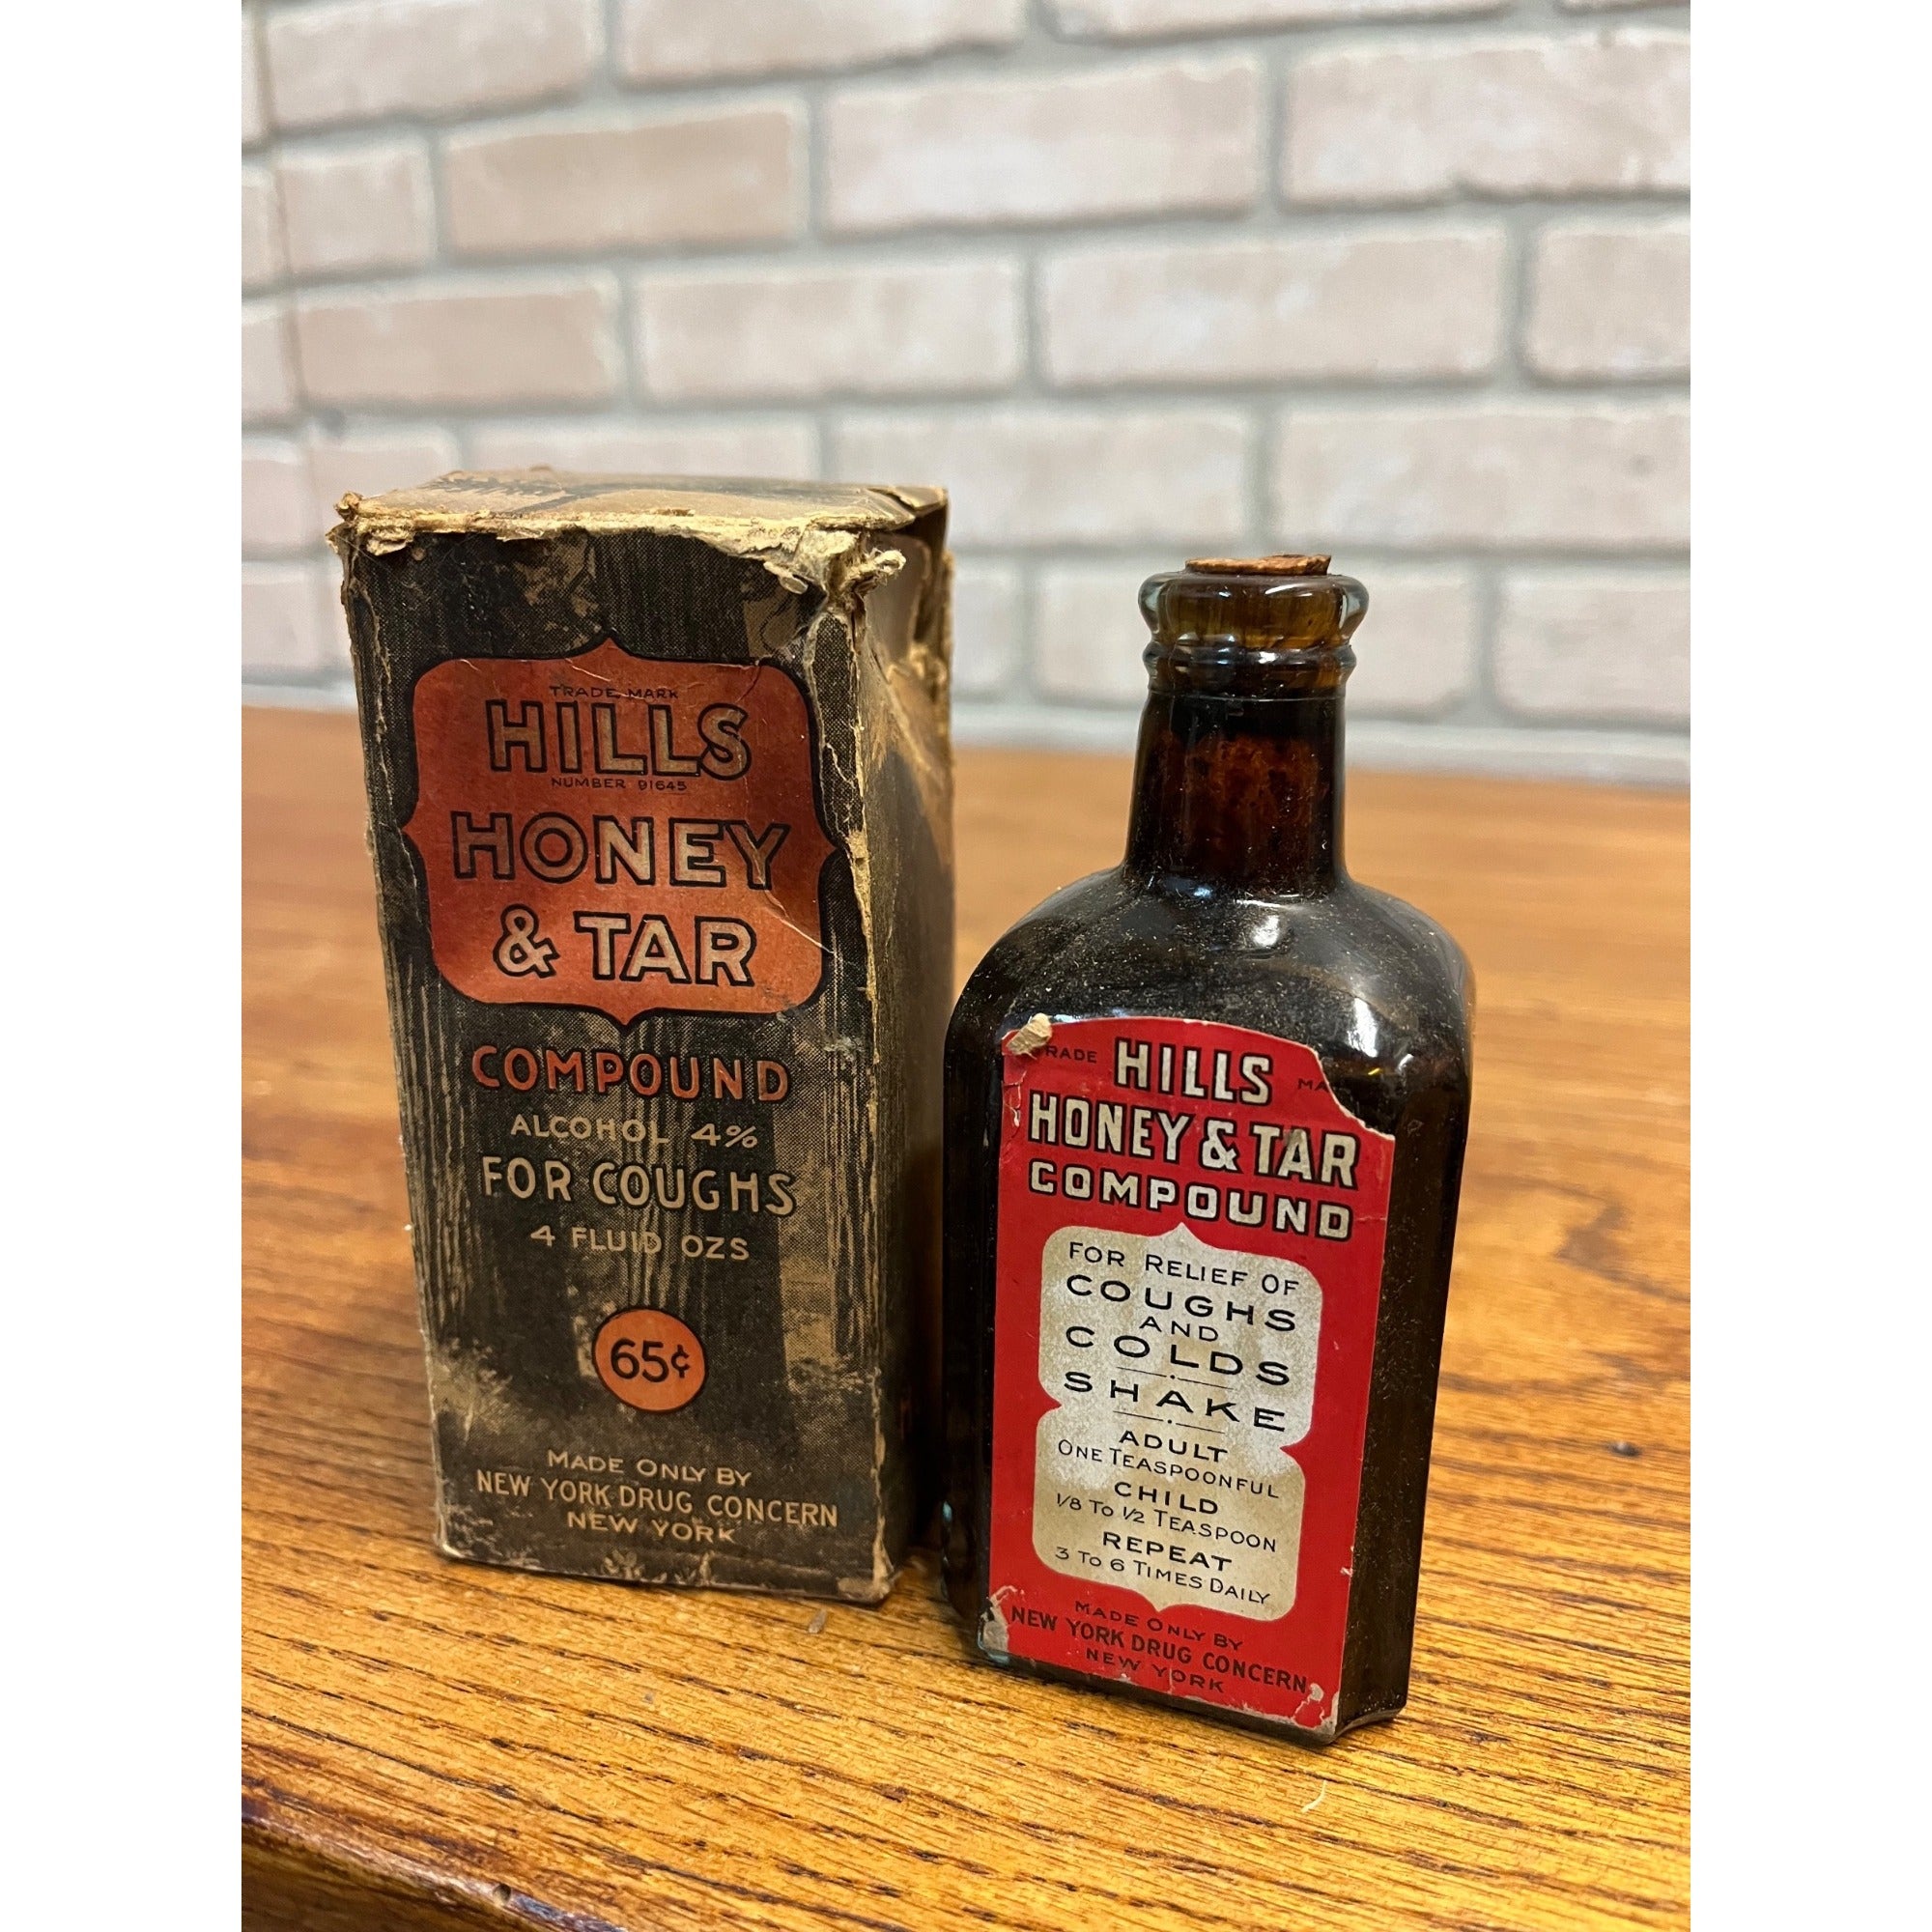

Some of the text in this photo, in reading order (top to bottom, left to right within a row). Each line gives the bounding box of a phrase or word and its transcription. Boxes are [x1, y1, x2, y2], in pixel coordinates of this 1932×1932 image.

[549, 686, 679, 699] TRADE MARK
[486, 699, 753, 781] HILLS
[552, 777, 626, 789] NUMBER
[450, 811, 791, 890] HONEY
[493, 904, 756, 986] & TAR
[471, 1045, 790, 1103] COMPOUND
[1037, 1037, 1329, 1106] RADE HILLS MA
[510, 1114, 758, 1150] ALCOHOL 4%
[1028, 1090, 1361, 1191] HONEY & TAR
[481, 1156, 796, 1215] FOR COUGHS
[1029, 1159, 1354, 1242] COMPOUND
[530, 1225, 749, 1261] 4 FLUID OZS
[1069, 1242, 1299, 1295] FOR RELIEF OF
[1066, 1274, 1296, 1332] COUGHS
[1139, 1316, 1219, 1342] AND
[610, 1338, 691, 1383] 65¢
[1065, 1325, 1291, 1387] COLDS
[1064, 1371, 1286, 1433] SHAKE
[548, 1450, 753, 1488] MADE ONLY BY
[1058, 1439, 1280, 1499] ONE TEASPOONFUL
[1119, 1430, 1228, 1463] ADULT
[476, 1469, 838, 1528] NEW YORK DRUG CONCERN
[1114, 1482, 1218, 1515] CHILD
[568, 1512, 735, 1544] NEW YORK
[1103, 1531, 1233, 1572] REPEAT
[1154, 1510, 1276, 1552] TEASPOON
[1055, 1547, 1069, 1560] 3
[1110, 1558, 1125, 1572] 6
[1133, 1561, 1203, 1590] TIMES
[1209, 1578, 1270, 1605] DAILY
[1011, 1606, 1308, 1694] NEW YORK DRUG CONCERN
[1075, 1601, 1243, 1651] MADE ONLY BY
[1086, 1648, 1225, 1692] NEW YORK
